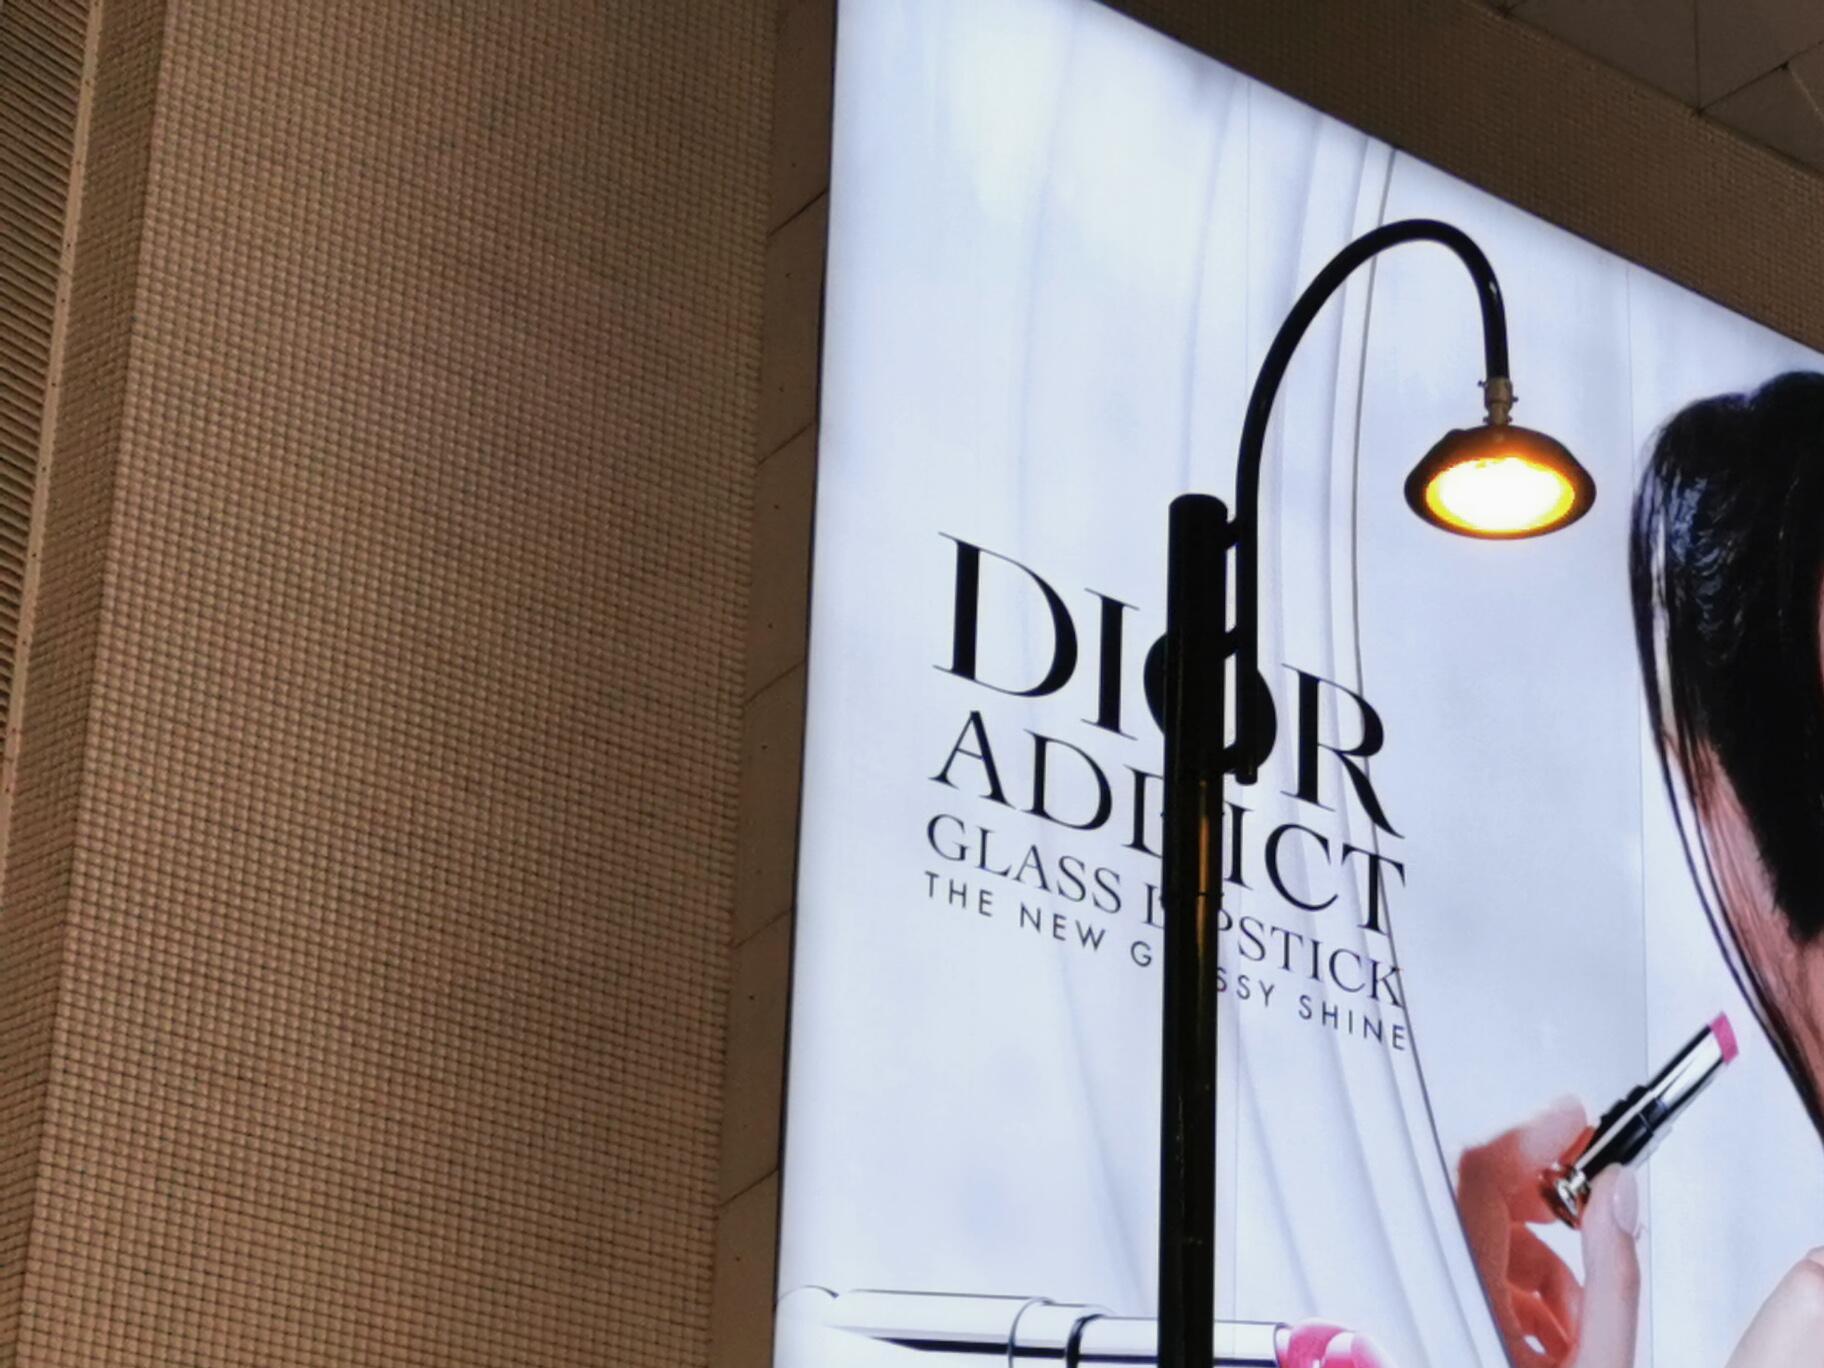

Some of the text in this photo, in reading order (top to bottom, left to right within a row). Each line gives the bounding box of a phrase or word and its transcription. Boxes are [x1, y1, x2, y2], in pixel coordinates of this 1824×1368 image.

[924, 870, 1408, 1051] THE NEW GSSY SHINE
[926, 813, 1404, 1010] GLASS LSTICK
